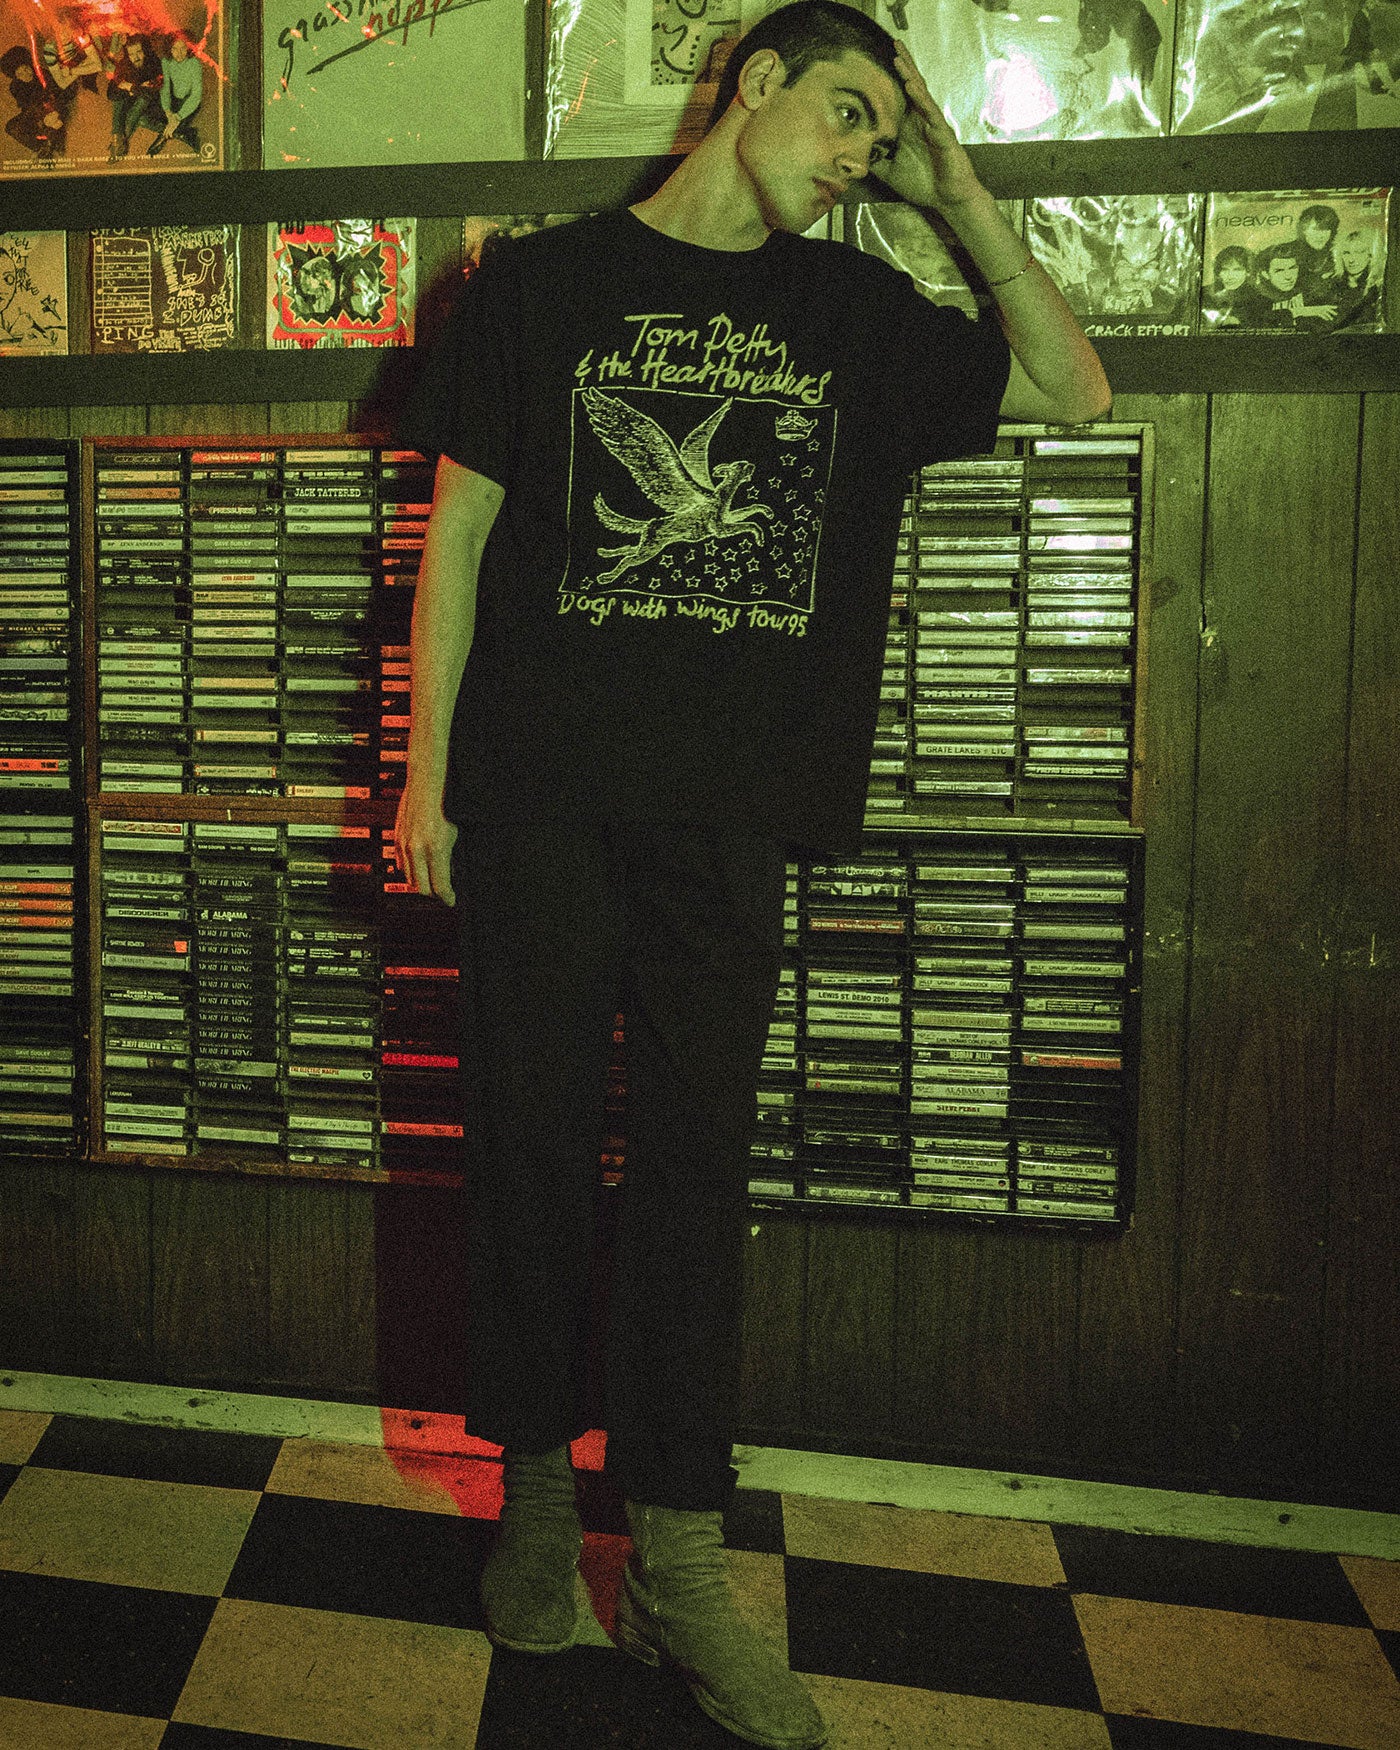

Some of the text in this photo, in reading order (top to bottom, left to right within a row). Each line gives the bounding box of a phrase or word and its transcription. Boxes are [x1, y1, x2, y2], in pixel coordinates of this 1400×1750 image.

[1216, 211, 1293, 228] heaven
[101, 327, 155, 344] PING
[1085, 324, 1190, 337] CRACK EFFORT
[623, 312, 788, 374] Tom Petty
[598, 350, 633, 382] the
[640, 347, 833, 406] Heartbreakers
[294, 487, 362, 499] JACK TATTERED
[925, 744, 953, 753] GRATE
[953, 745, 981, 755] LAKES
[212, 911, 248, 920] ALABAMA
[818, 991, 840, 1000] LEWIS
[852, 994, 872, 1002] DEMO
[945, 1087, 986, 1096] ALABAMA
